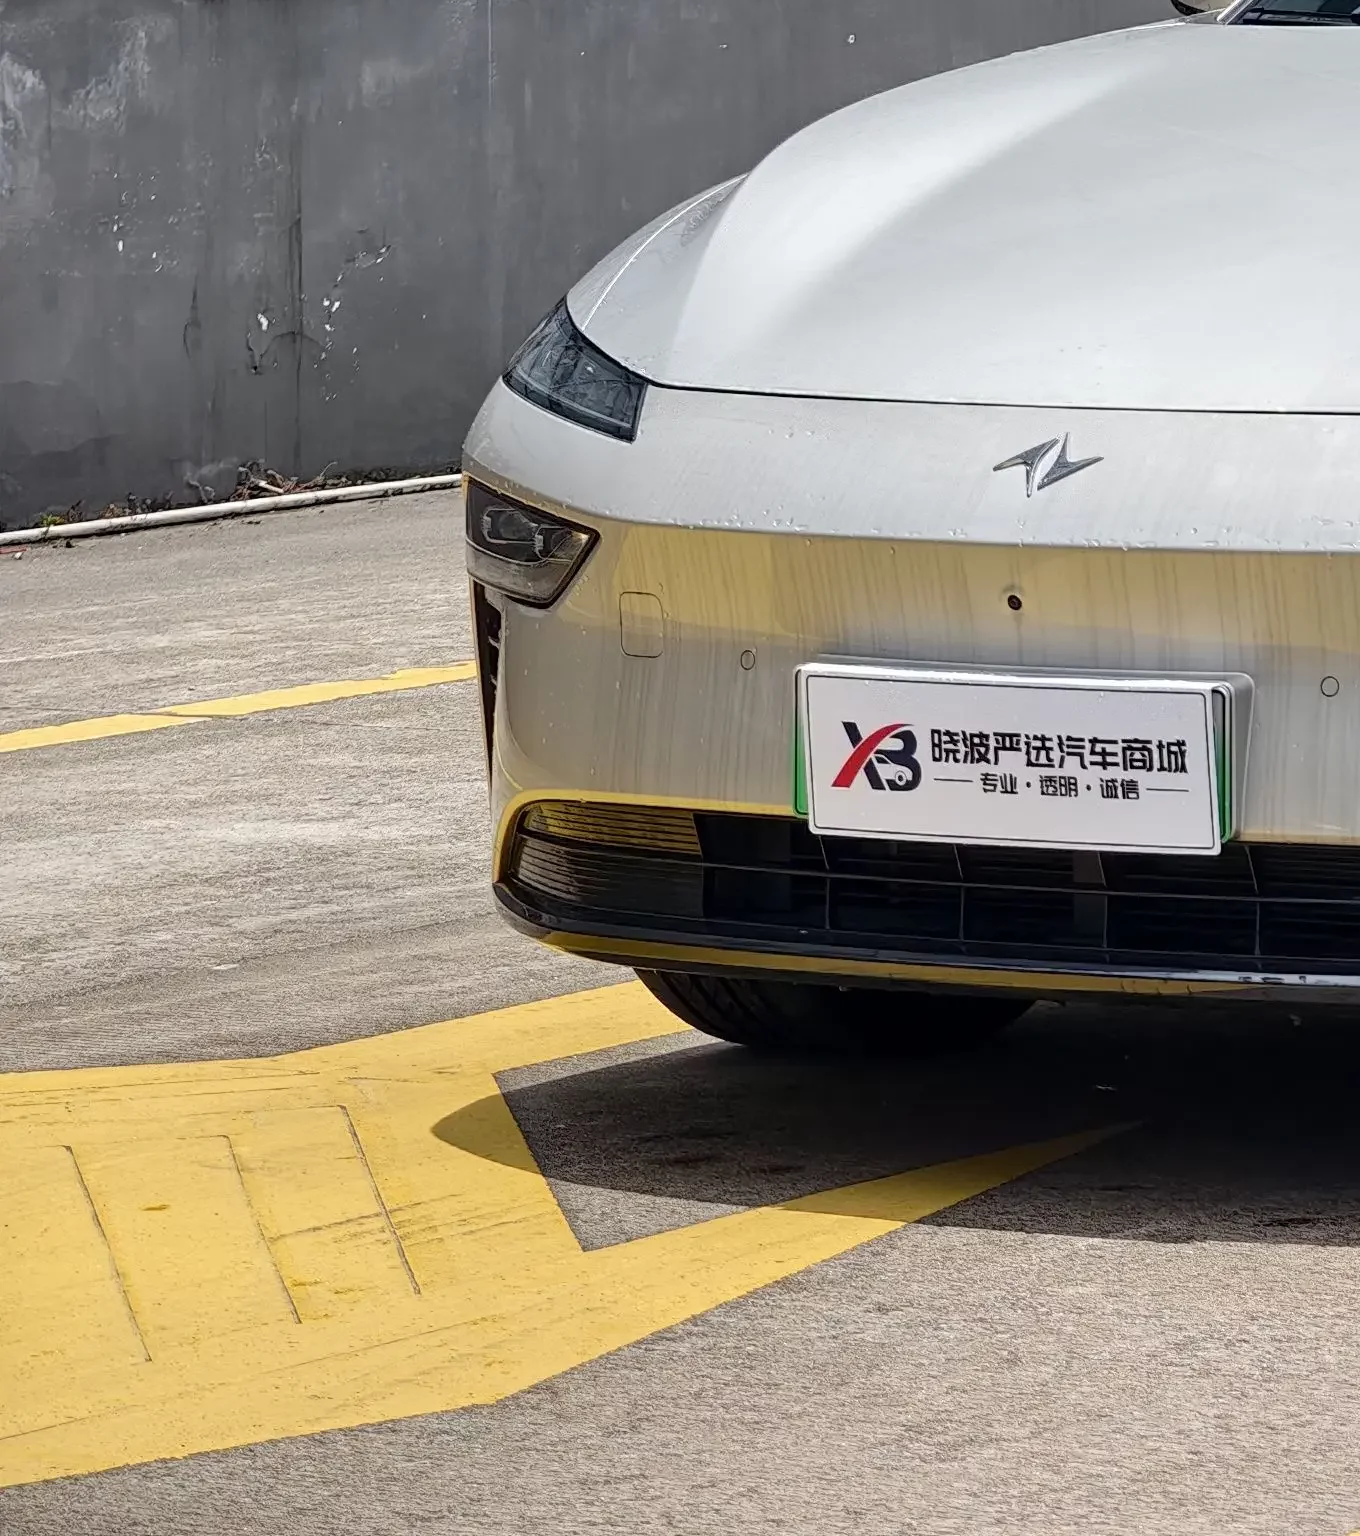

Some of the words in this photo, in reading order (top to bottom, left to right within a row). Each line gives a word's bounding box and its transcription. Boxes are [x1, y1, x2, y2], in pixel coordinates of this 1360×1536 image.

[929, 728, 1190, 774] 晓波严选汽车商城
